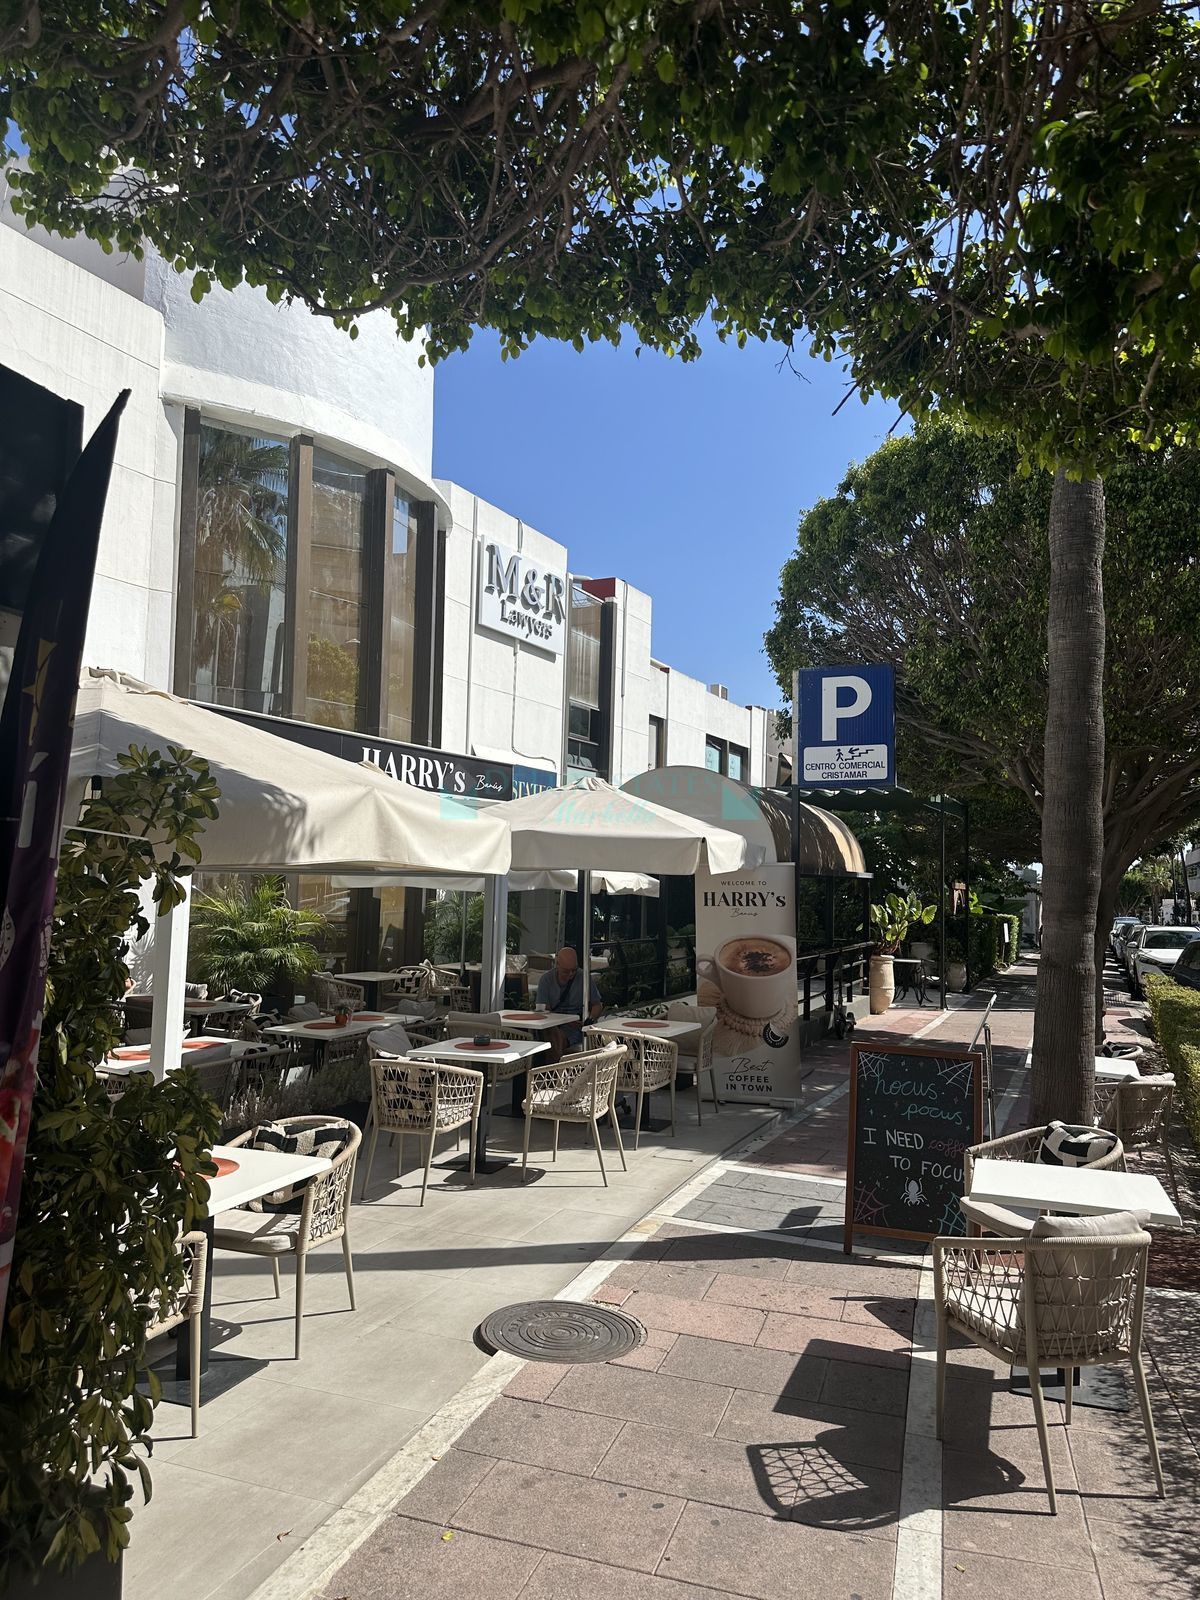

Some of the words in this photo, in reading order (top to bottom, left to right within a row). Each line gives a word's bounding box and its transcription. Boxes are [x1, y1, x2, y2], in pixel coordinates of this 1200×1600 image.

[484, 543, 566, 624] M&R
[500, 599, 553, 640] Lawyers
[822, 675, 872, 741] P
[805, 761, 836, 771] CENTRO
[838, 760, 886, 770] COMERCIAL
[821, 770, 868, 780] CRISTAMAR
[703, 891, 786, 907] HARRY's
[721, 1057, 775, 1074] Best
[728, 1074, 769, 1083] COFFEE
[740, 1083, 773, 1092] TOWN
[901, 1103, 962, 1125] pocus
[863, 1127, 877, 1145] I
[886, 1129, 924, 1150] NEED
[928, 1138, 968, 1159] coffe
[889, 1155, 911, 1171] TO
[921, 1161, 964, 1182] FOCU
